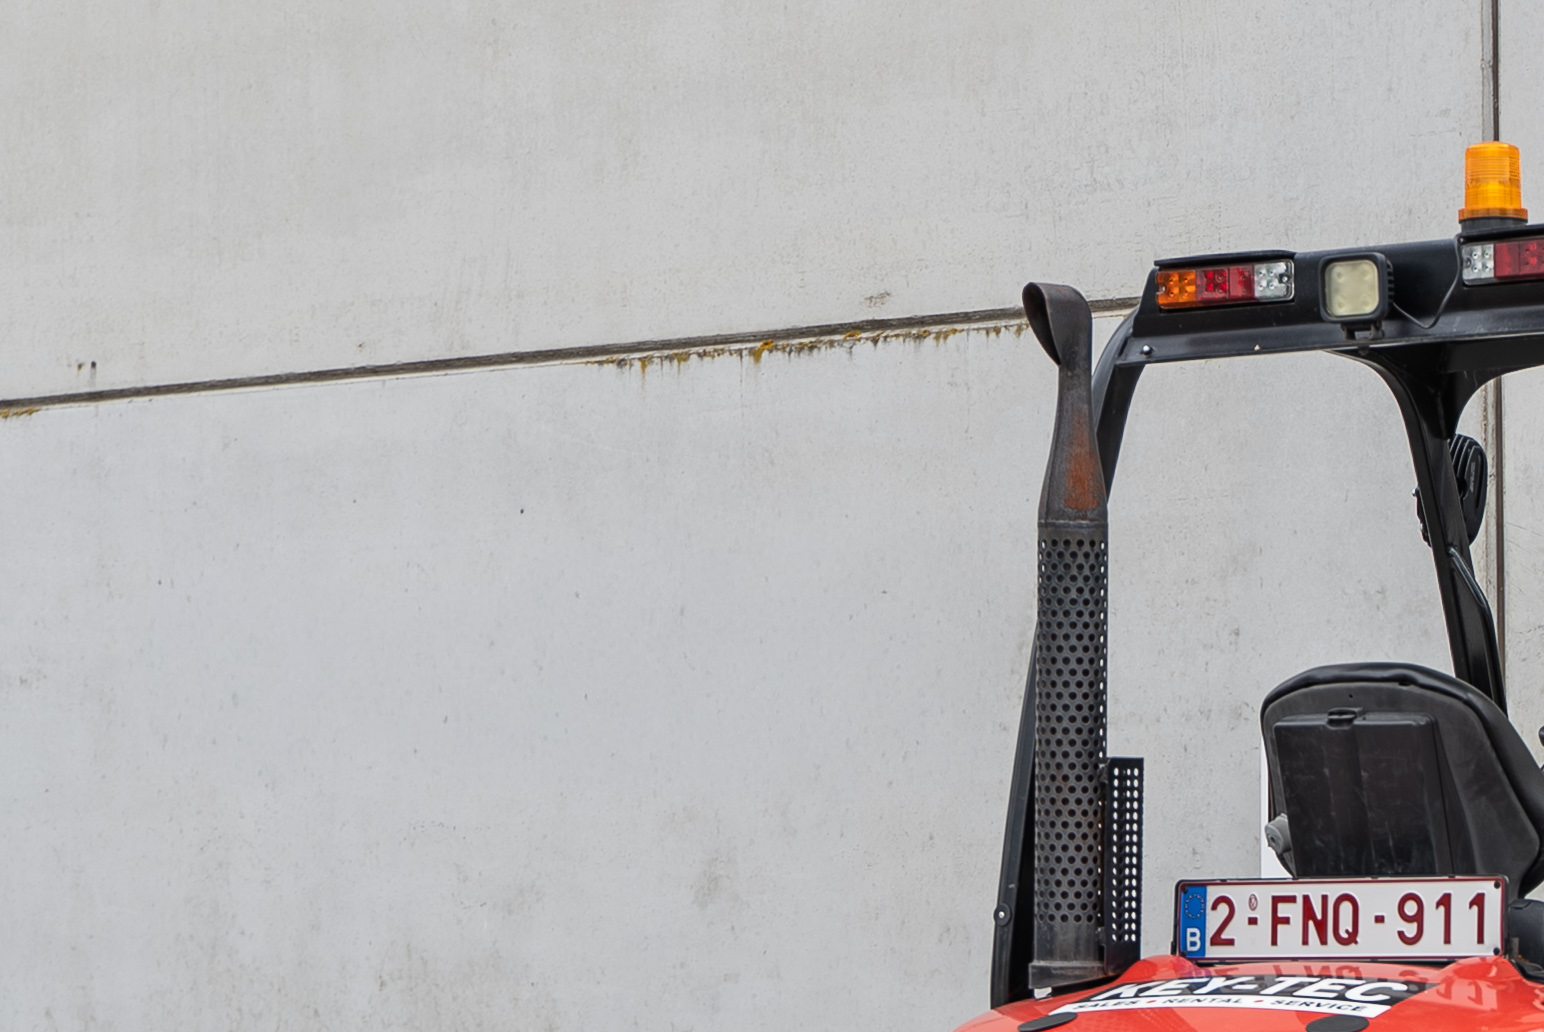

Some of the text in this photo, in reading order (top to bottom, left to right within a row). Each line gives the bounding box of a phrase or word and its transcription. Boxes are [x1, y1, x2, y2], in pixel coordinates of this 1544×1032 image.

[1185, 926, 1202, 953] B
[1091, 976, 1408, 1003] KEY-TEC
[1270, 999, 1366, 1013] SERVICE
